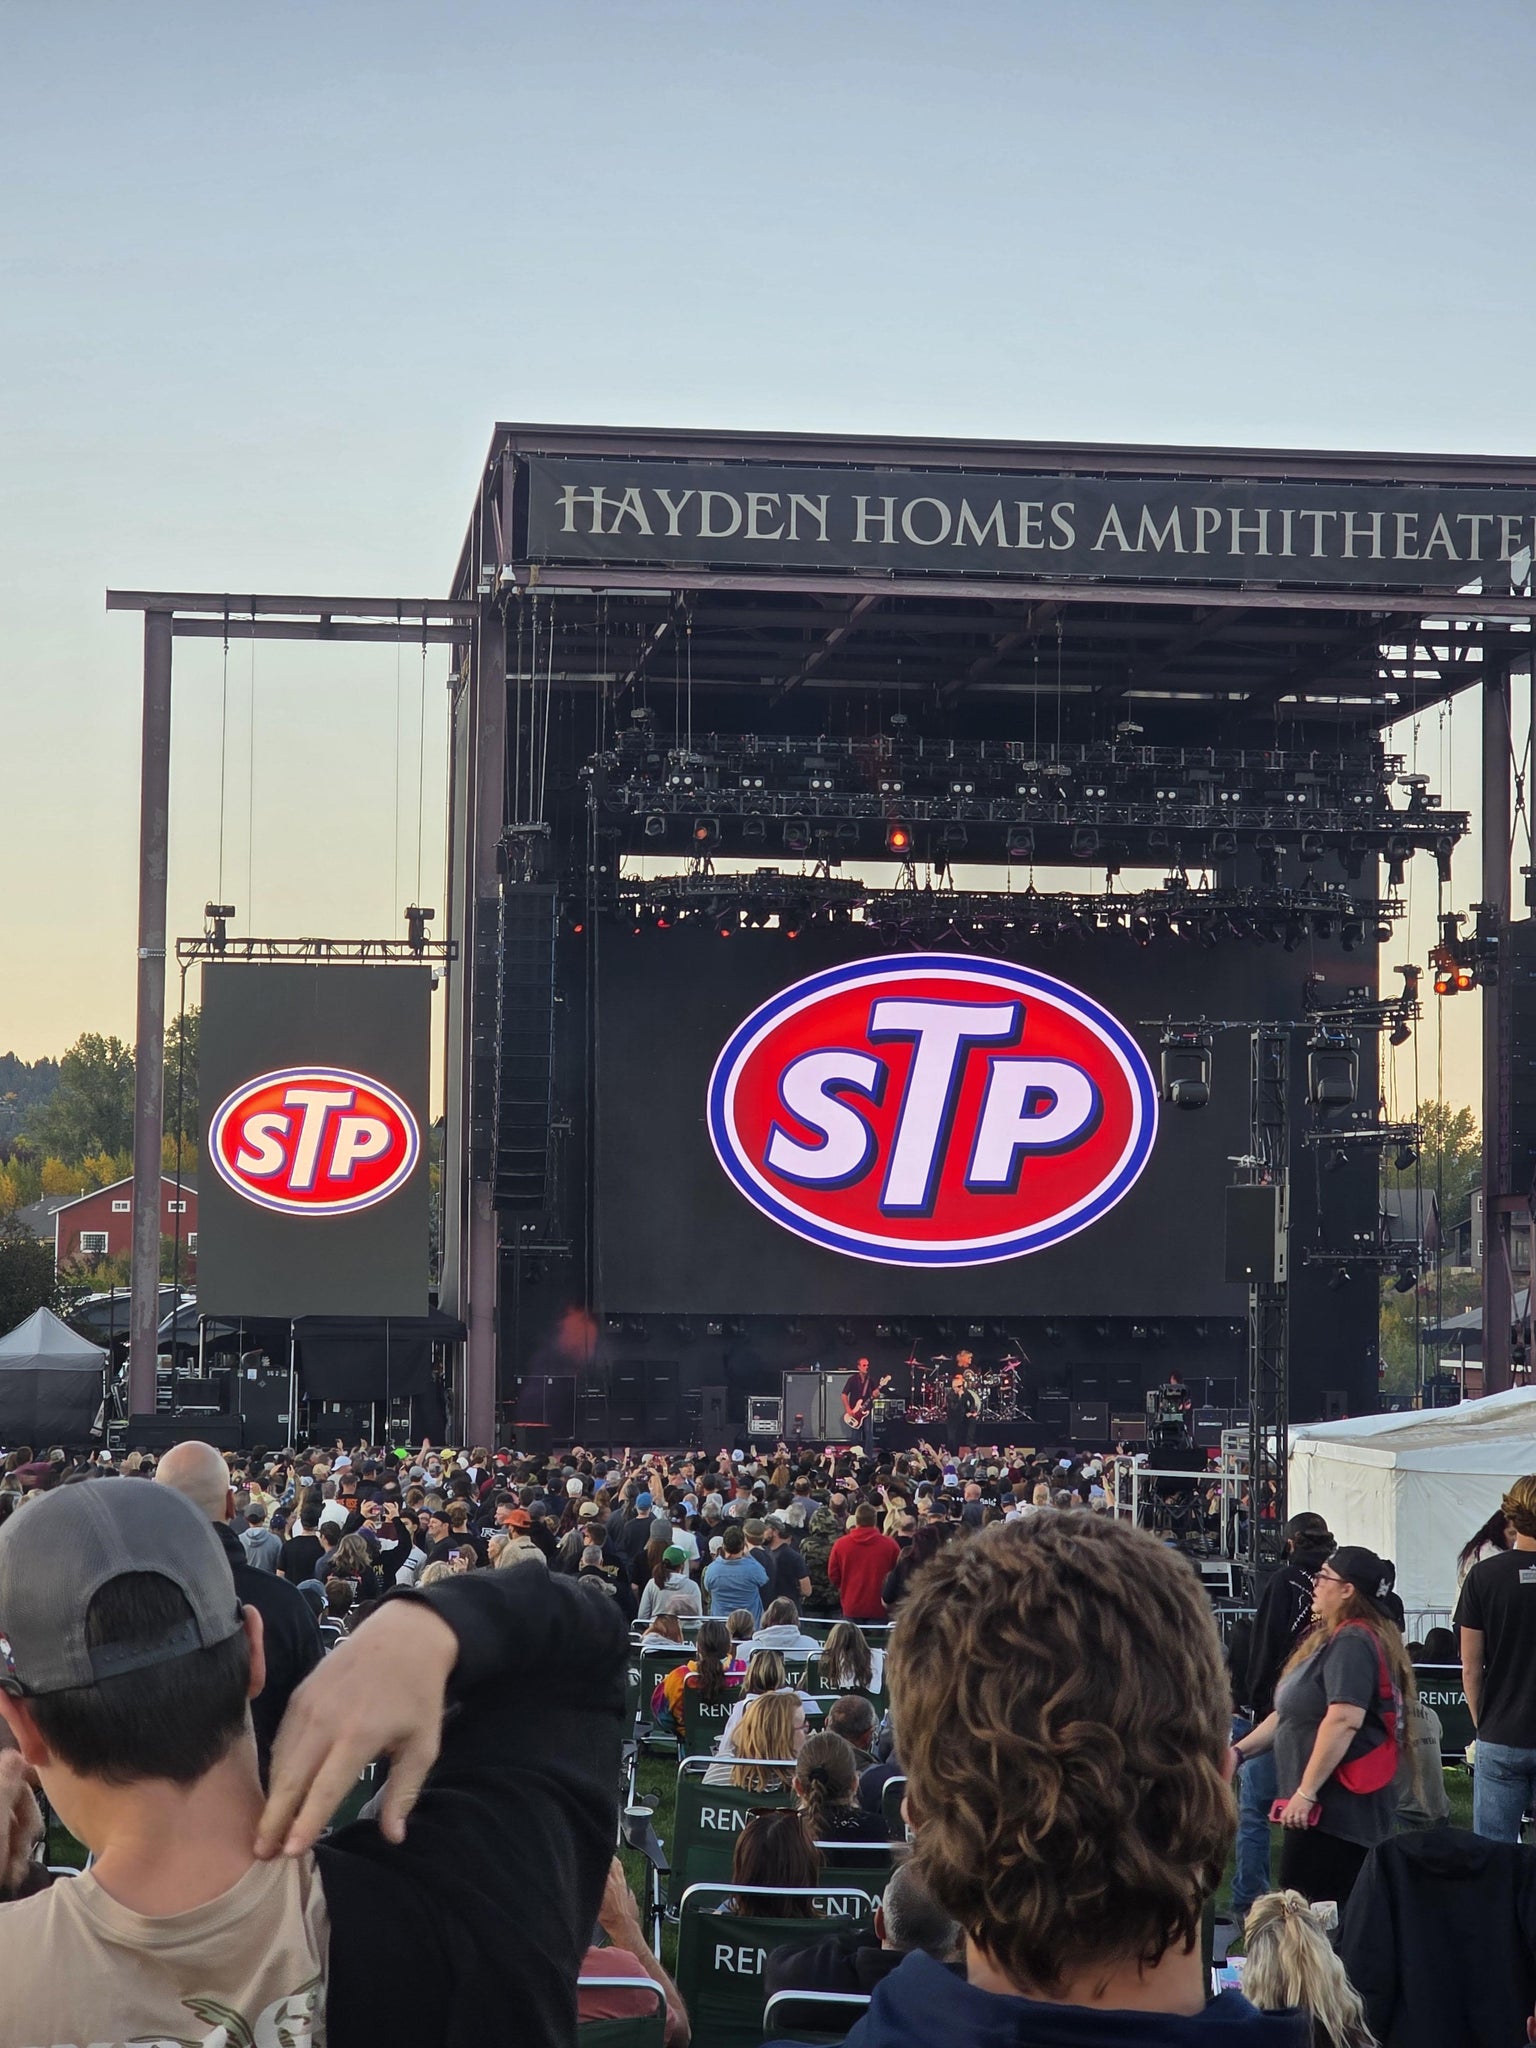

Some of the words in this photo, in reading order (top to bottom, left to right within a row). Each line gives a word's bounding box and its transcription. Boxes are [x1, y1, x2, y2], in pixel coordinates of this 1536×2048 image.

[555, 485, 831, 542] HAYDEN
[851, 495, 1076, 551] HOMES
[1091, 502, 1536, 562] AMPHITHEATE
[235, 1088, 393, 1191] STP
[764, 997, 1104, 1218] STP
[1419, 1691, 1469, 1705] RENTA
[700, 1807, 747, 1831] REN
